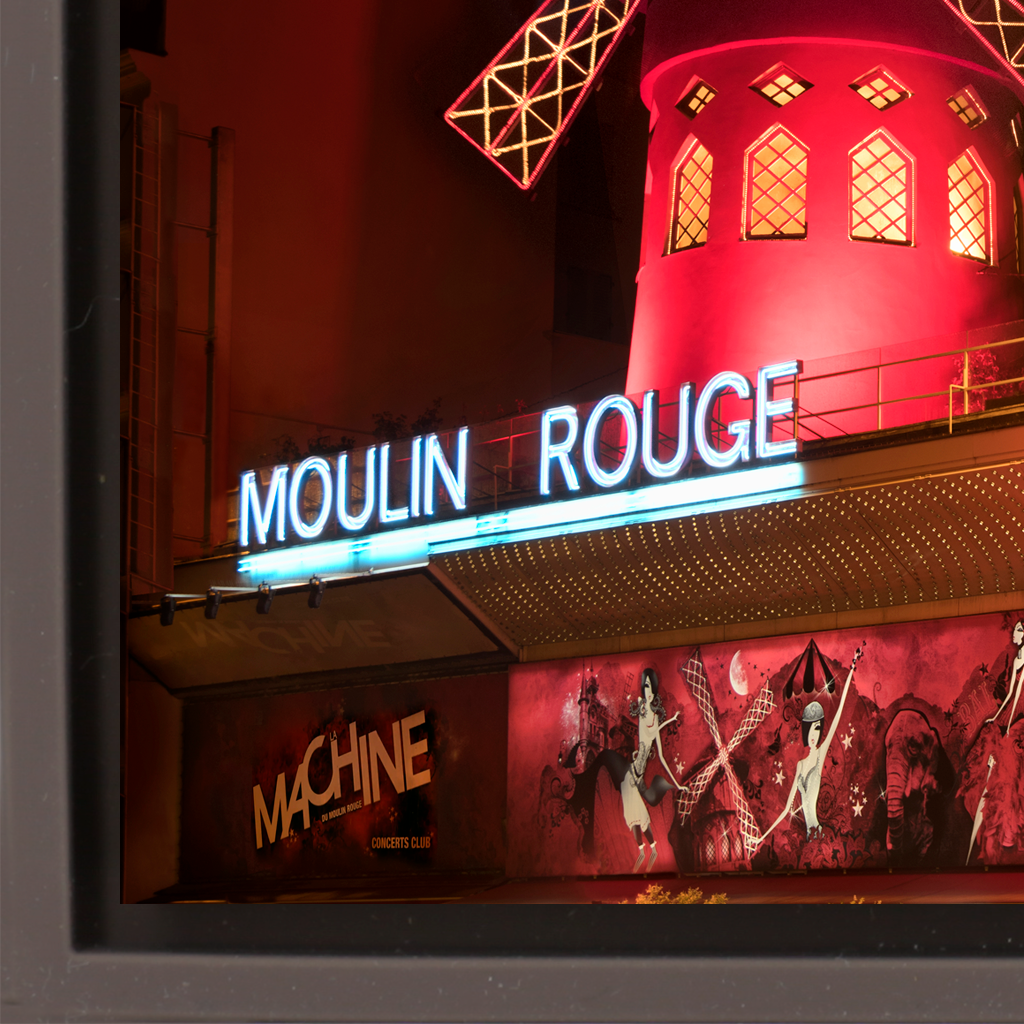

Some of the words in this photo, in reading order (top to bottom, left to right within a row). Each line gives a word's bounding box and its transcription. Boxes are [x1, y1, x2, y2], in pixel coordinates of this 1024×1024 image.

[238, 425, 470, 548] MOULIN
[539, 359, 799, 495] ROUGE
[330, 730, 338, 742] LA
[253, 710, 431, 850] MACHINE
[321, 813, 328, 823] DU
[329, 806, 346, 820] MOULIN
[347, 800, 362, 813] ROUGE
[371, 836, 409, 849] CONCERTS
[411, 836, 431, 849] CLUB
